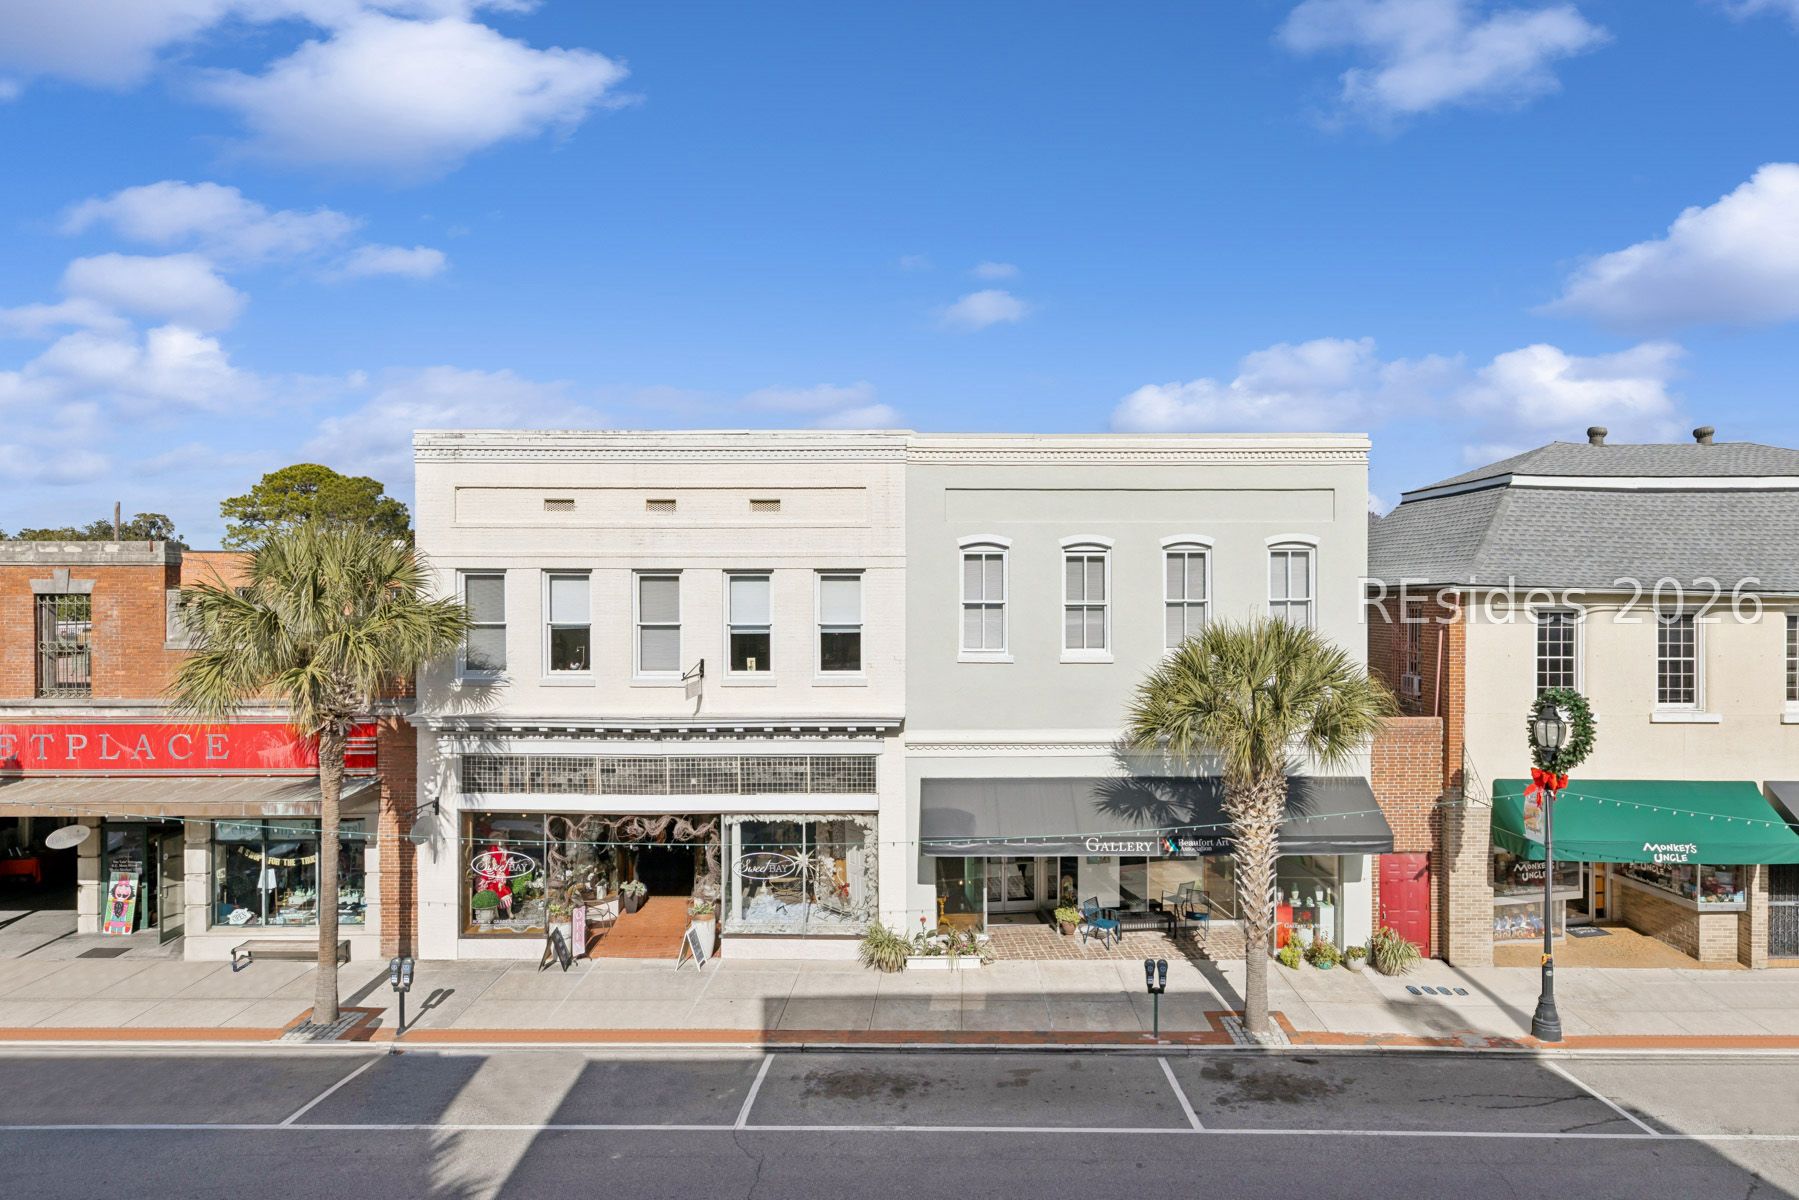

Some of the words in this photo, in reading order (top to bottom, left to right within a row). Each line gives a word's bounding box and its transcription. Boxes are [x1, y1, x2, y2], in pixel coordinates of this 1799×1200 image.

[0, 733, 230, 760] ETPLACE
[1085, 837, 1153, 852] GALLERY
[1178, 838, 1214, 847] Beaufort
[1215, 838, 1230, 846] Art
[1643, 842, 1697, 854] MONKEY'S
[268, 856, 280, 866] FOR
[283, 858, 296, 866] THE
[1653, 853, 1688, 863] UNCLE
[508, 864, 528, 872] BAY
[738, 858, 772, 873] Sweet
[769, 864, 788, 873] BAY
[1513, 861, 1555, 872] MONKES
[1640, 863, 1664, 876] UNCLE
